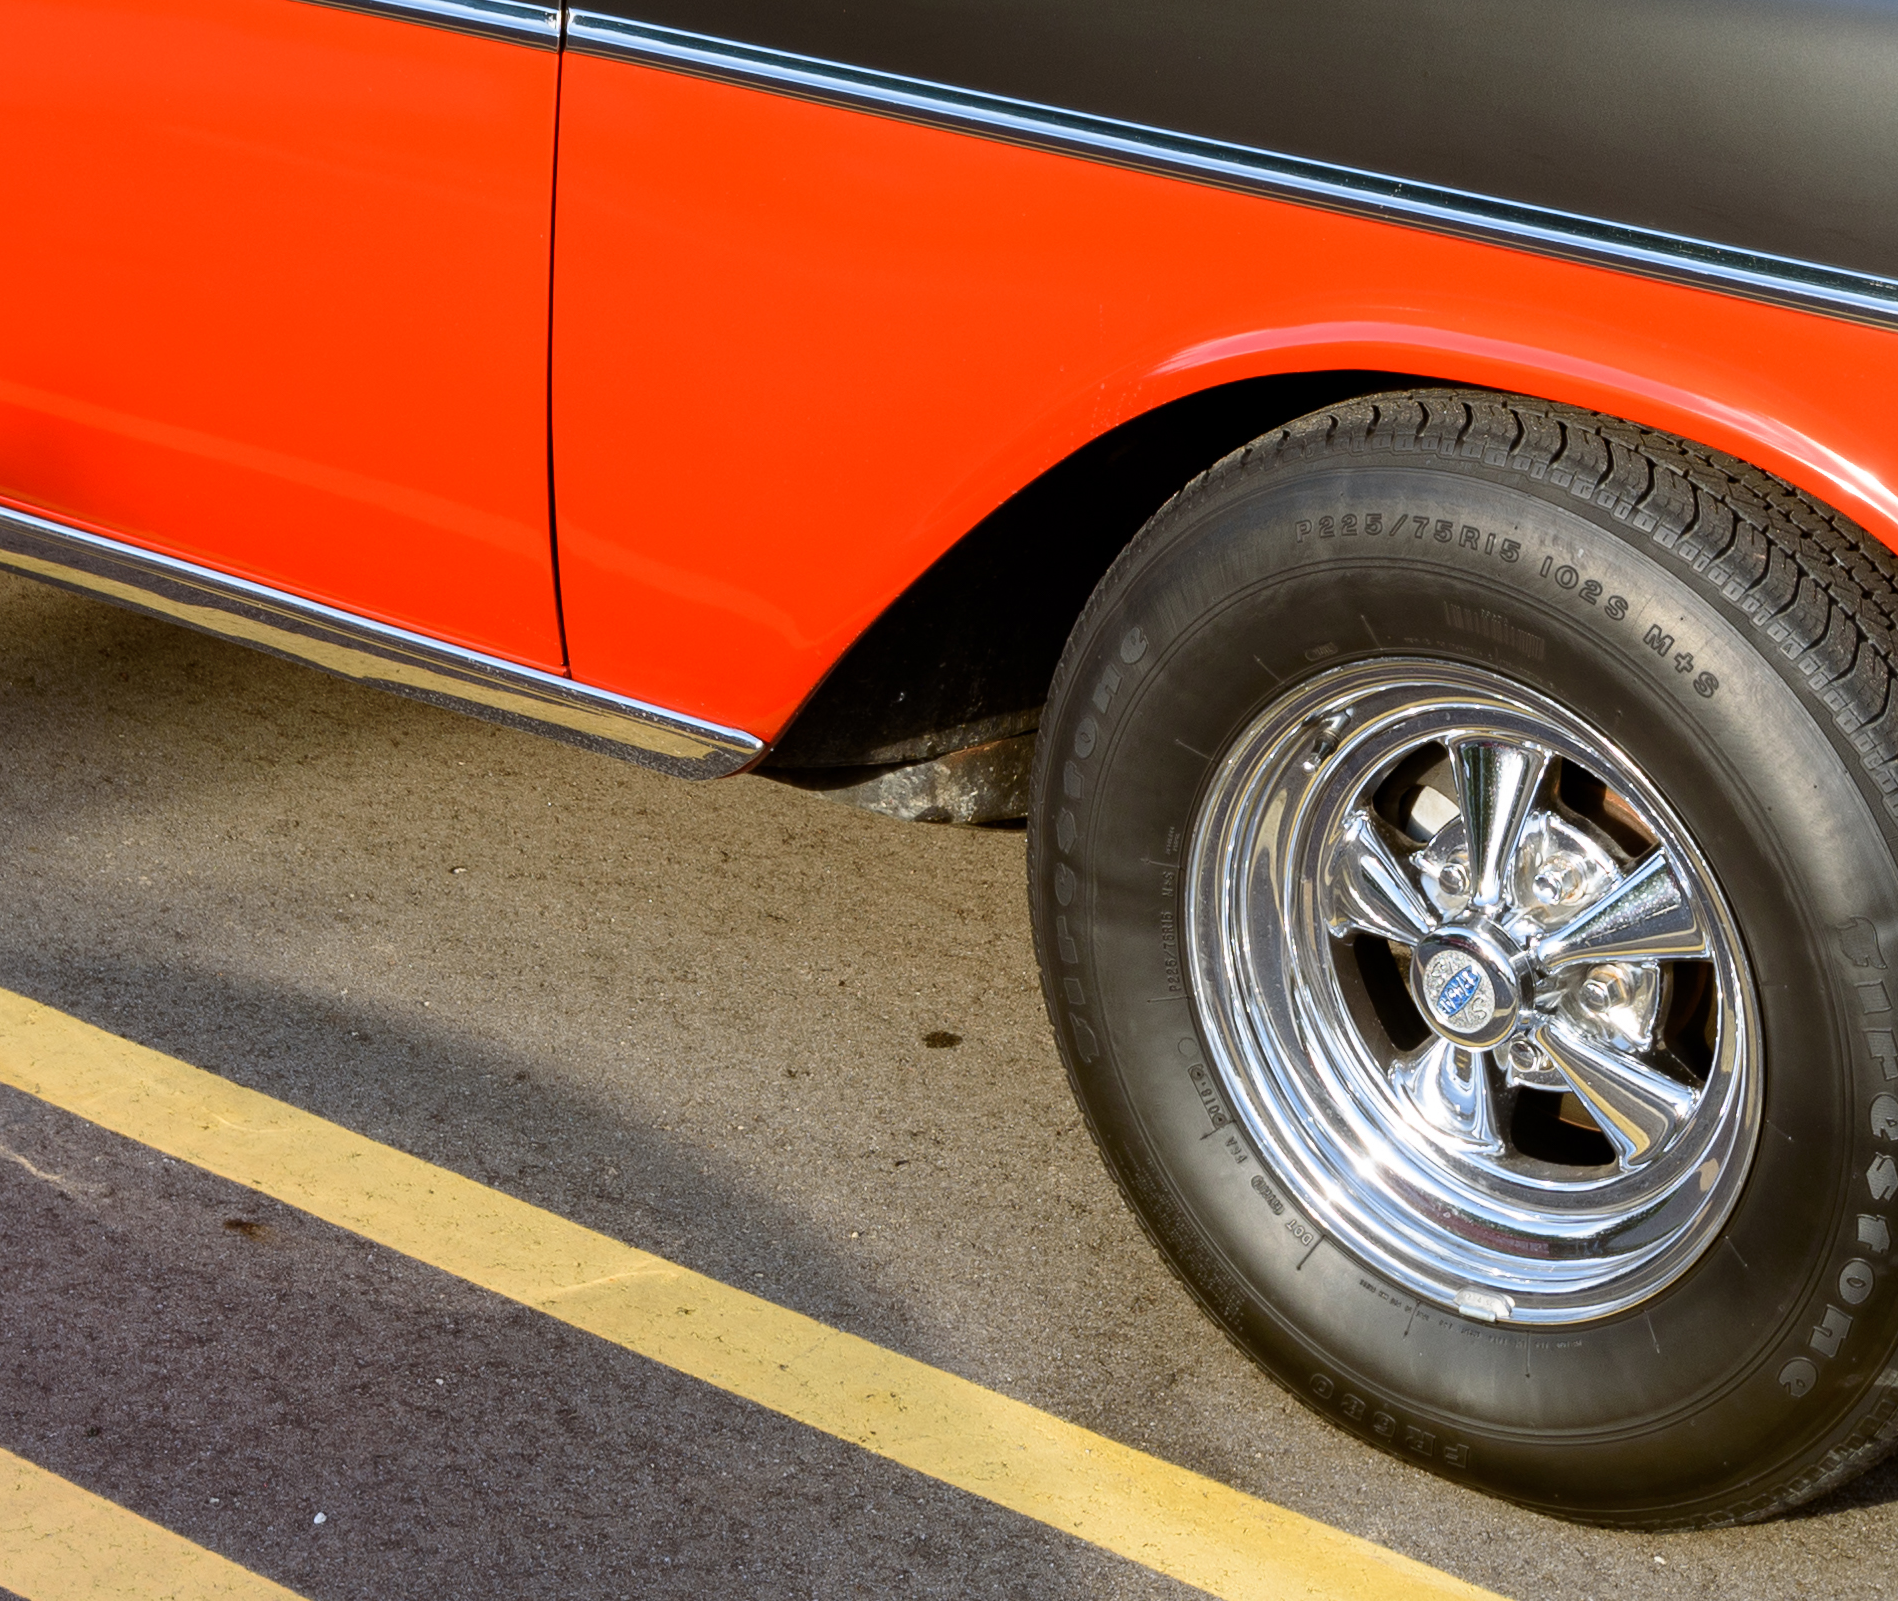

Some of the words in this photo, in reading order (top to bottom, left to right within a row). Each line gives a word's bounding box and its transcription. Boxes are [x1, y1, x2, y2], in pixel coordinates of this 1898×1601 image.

[1294, 512, 1522, 564] P225/75R15
[1539, 555, 1630, 622] 102S
[1642, 623, 1721, 698] M+S
[1285, 1218, 1314, 1246] DOT
